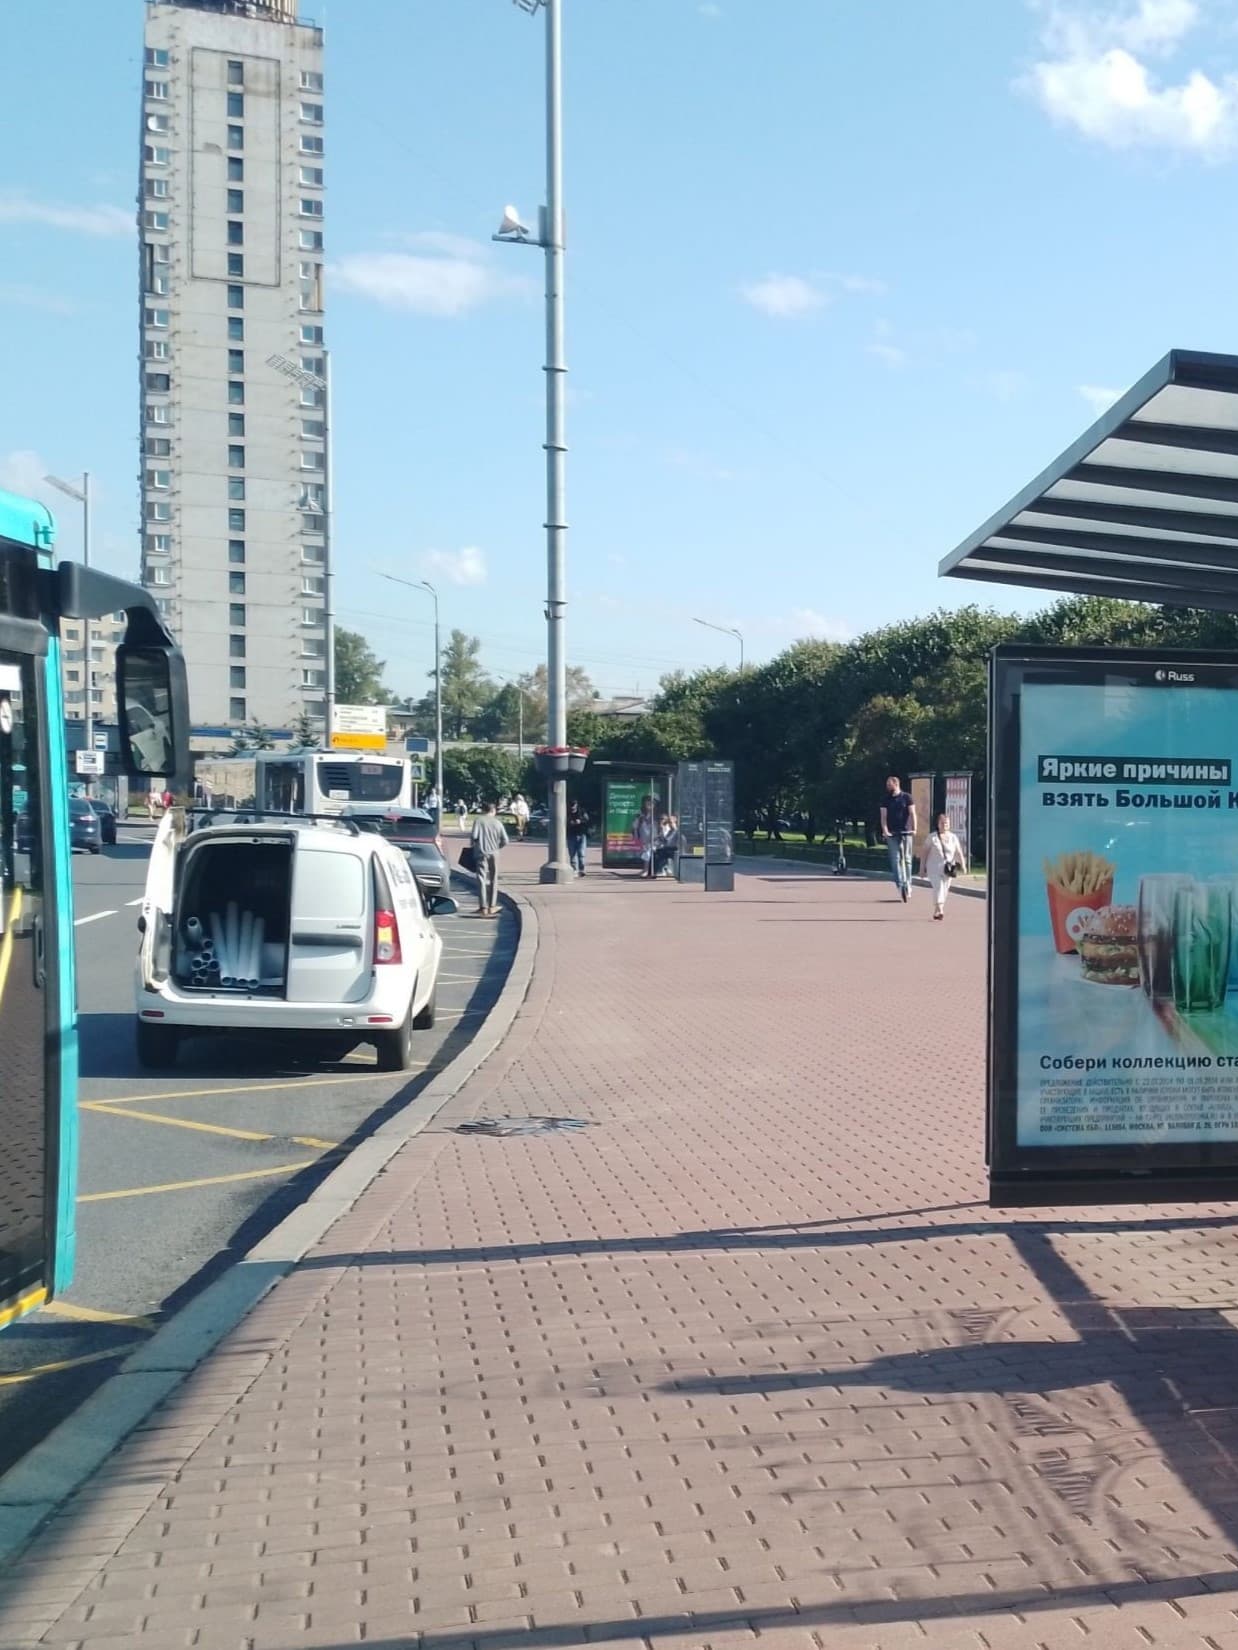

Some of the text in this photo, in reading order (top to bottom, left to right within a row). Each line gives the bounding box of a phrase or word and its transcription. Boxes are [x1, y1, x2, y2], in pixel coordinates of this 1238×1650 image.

[1167, 670, 1195, 682] Russ
[1042, 757, 1228, 780] Яркие причины
[1042, 792, 1109, 807] взять
[1116, 789, 1222, 809] Большой
[1040, 1055, 1107, 1072] Собери
[1112, 1054, 1212, 1071] коллекцию
